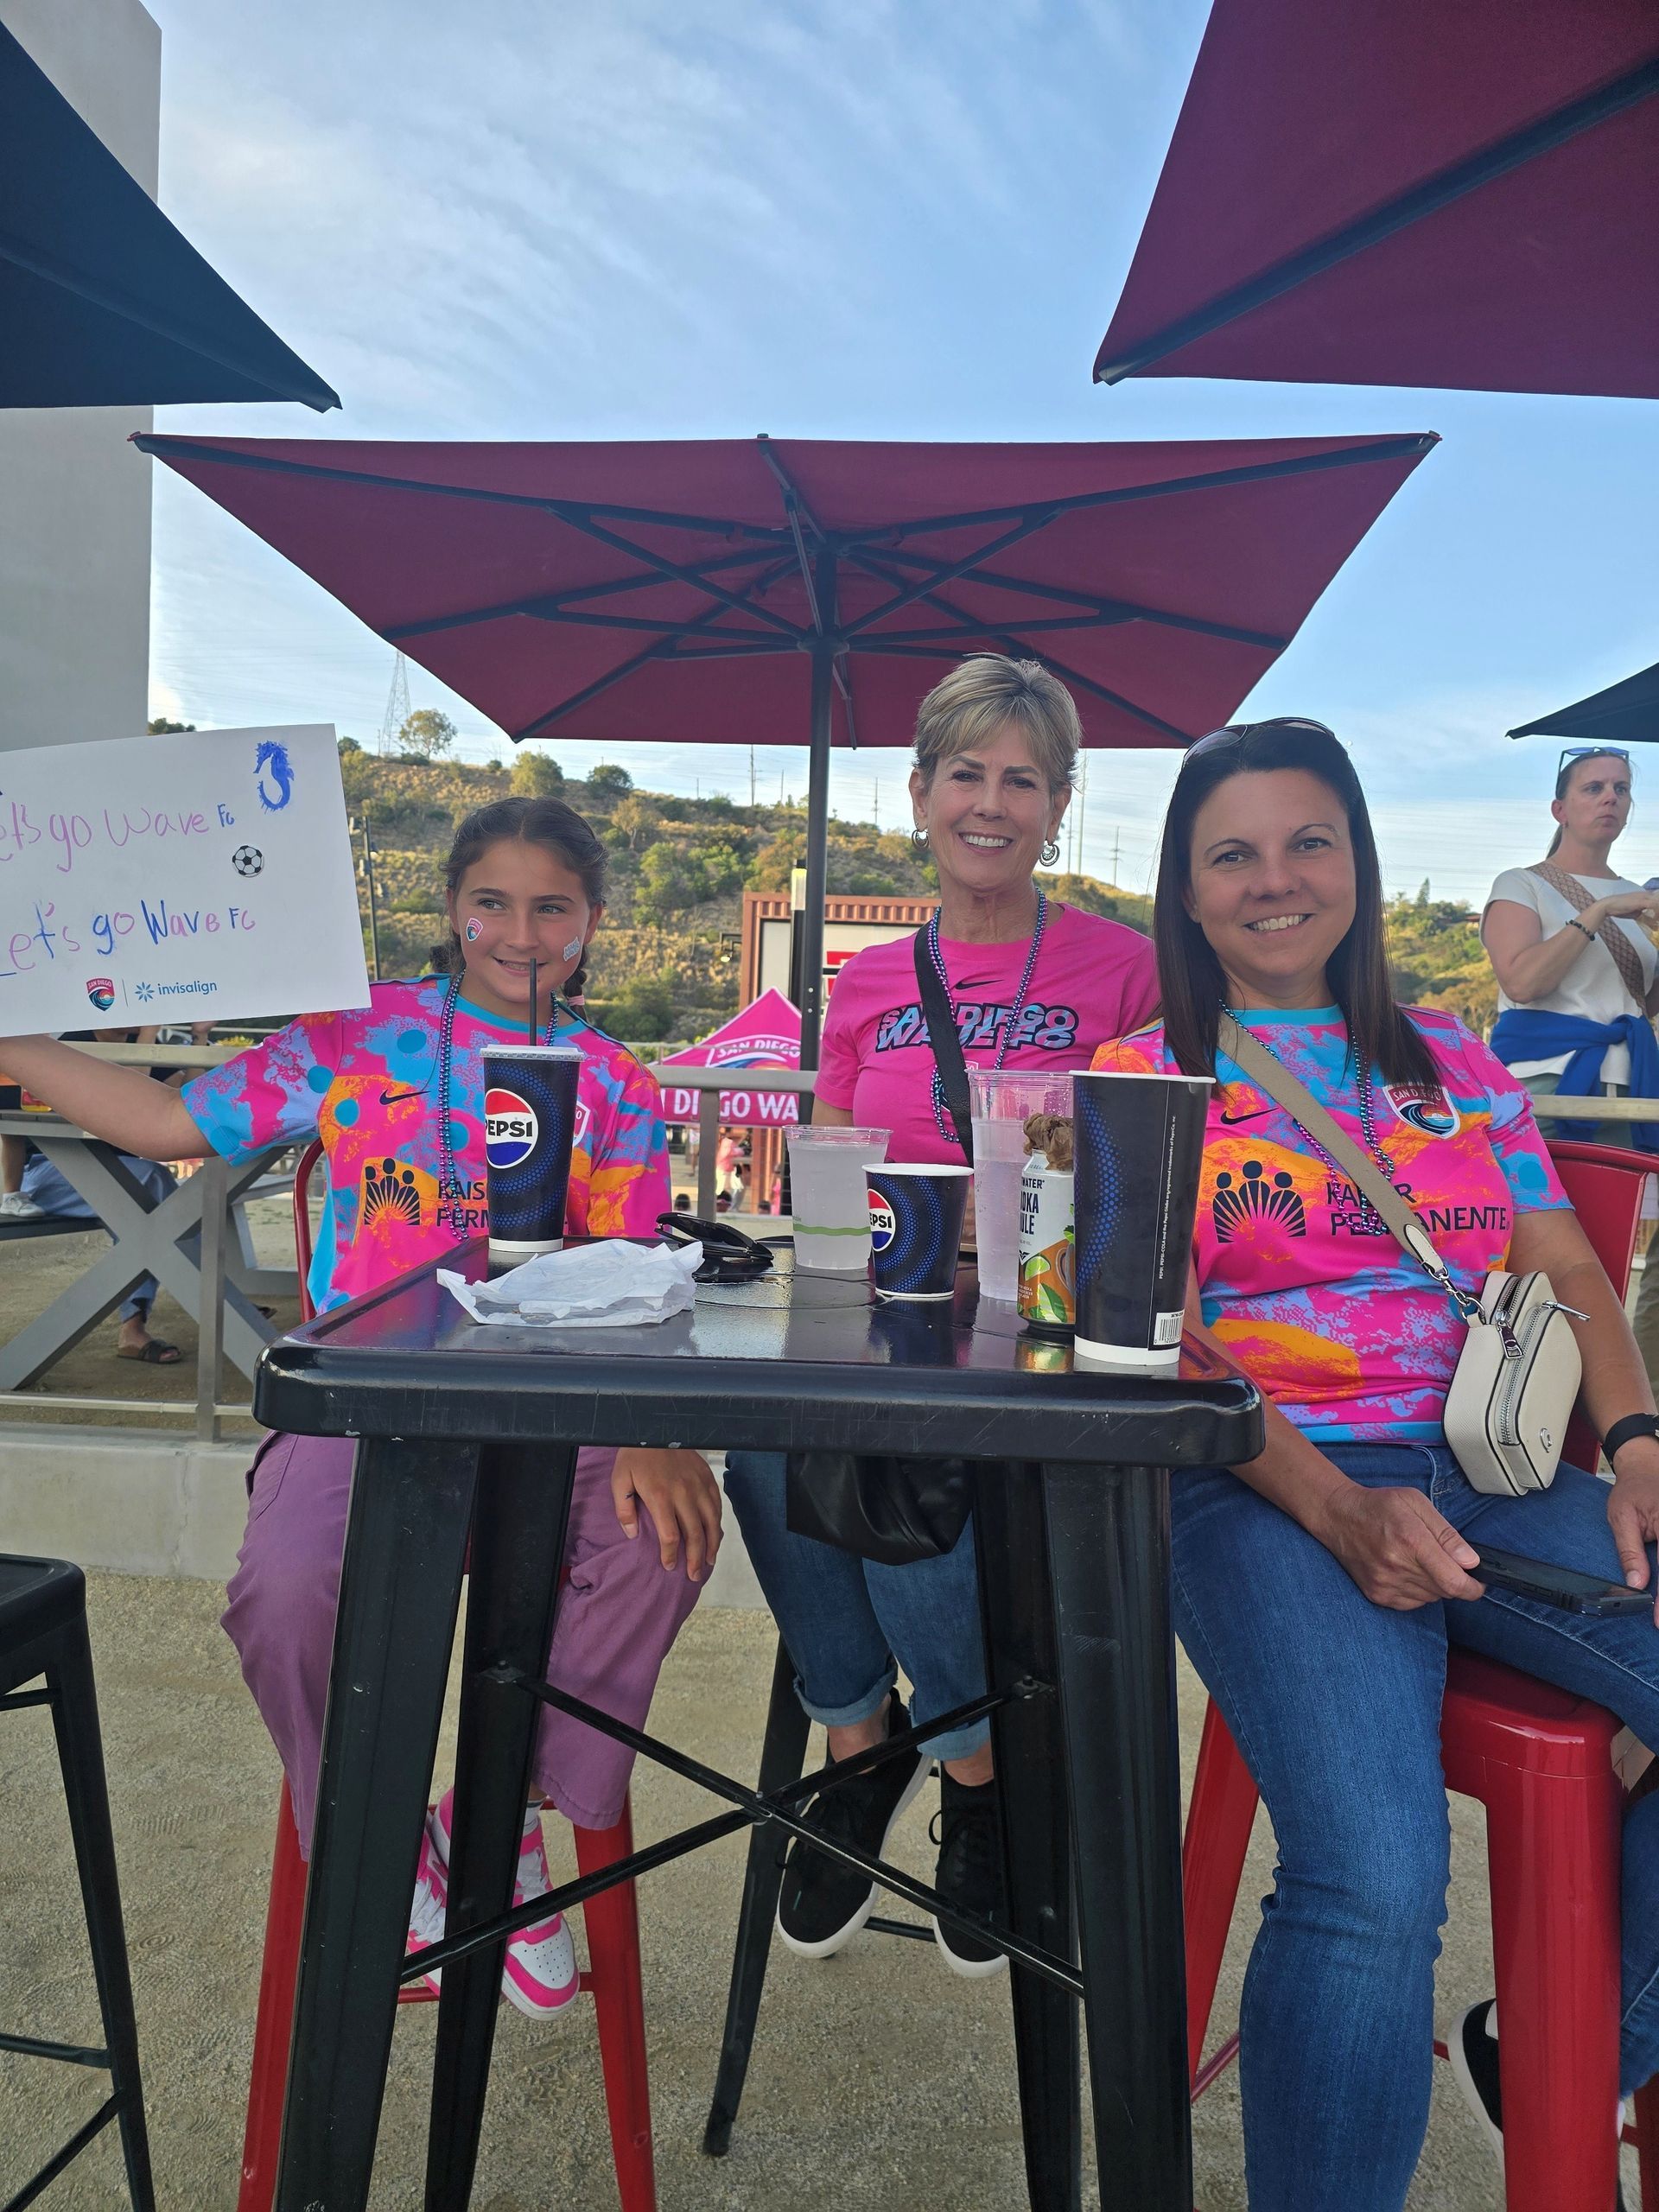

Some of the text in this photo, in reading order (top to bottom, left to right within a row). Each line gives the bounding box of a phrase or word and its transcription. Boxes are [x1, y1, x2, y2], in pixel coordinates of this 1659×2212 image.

[49, 813, 92, 873] go
[0, 900, 82, 976] et's
[92, 912, 135, 956] go
[88, 979, 112, 990] SAN DIEGO
[157, 980, 218, 995] invisalign
[880, 1004, 927, 1031] SA
[754, 1039, 801, 1058] DIEGO
[674, 1090, 751, 1119] DIGO
[1393, 1089, 1410, 1102] SAN
[486, 1119, 533, 1138] EPSI
